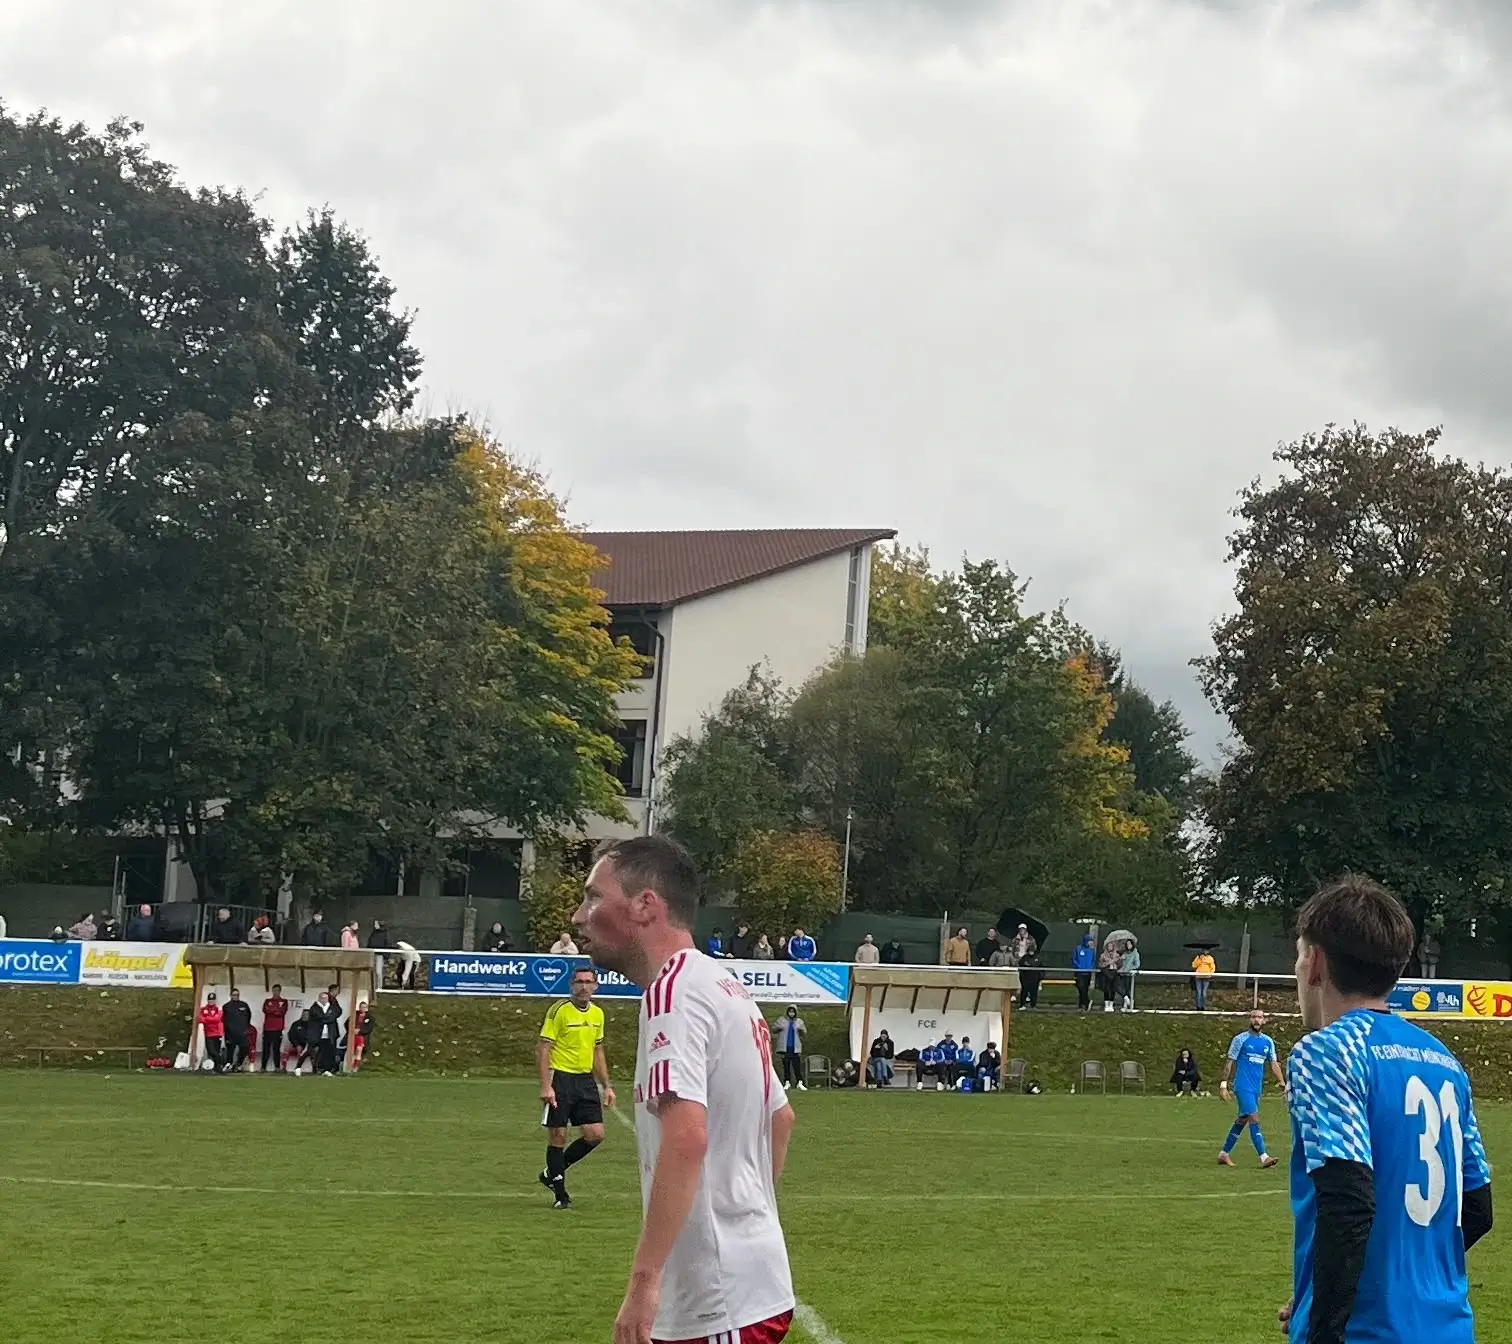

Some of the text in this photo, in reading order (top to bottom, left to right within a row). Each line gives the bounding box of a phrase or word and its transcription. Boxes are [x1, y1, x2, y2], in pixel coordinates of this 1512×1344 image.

[434, 959, 527, 975] Handwerk?
[743, 972, 787, 987] SELL
[918, 1019, 936, 1028] FCE
[1404, 1075, 1464, 1227] 31
